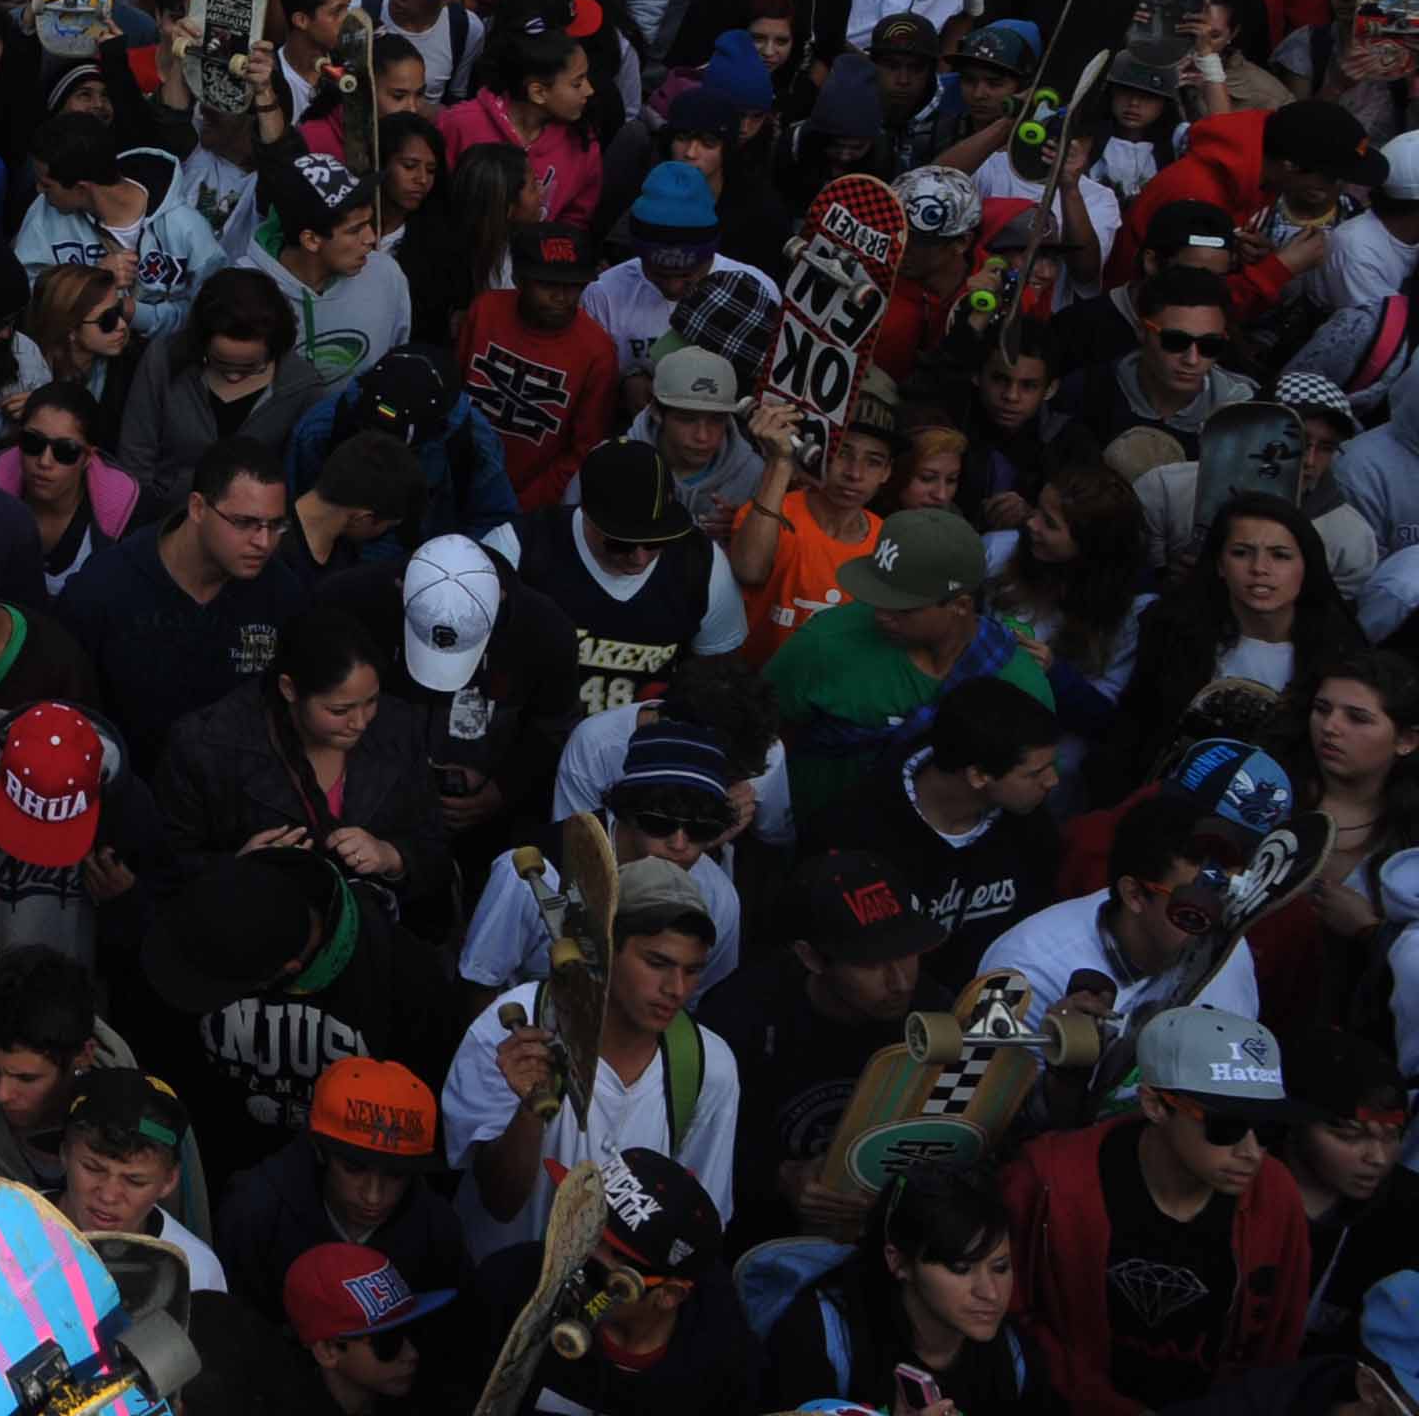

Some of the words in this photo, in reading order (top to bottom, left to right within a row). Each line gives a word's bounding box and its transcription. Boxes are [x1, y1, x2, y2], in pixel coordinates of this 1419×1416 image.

[874, 538, 899, 572] NY
[843, 880, 902, 927] VANS
[910, 877, 1017, 930] odgers
